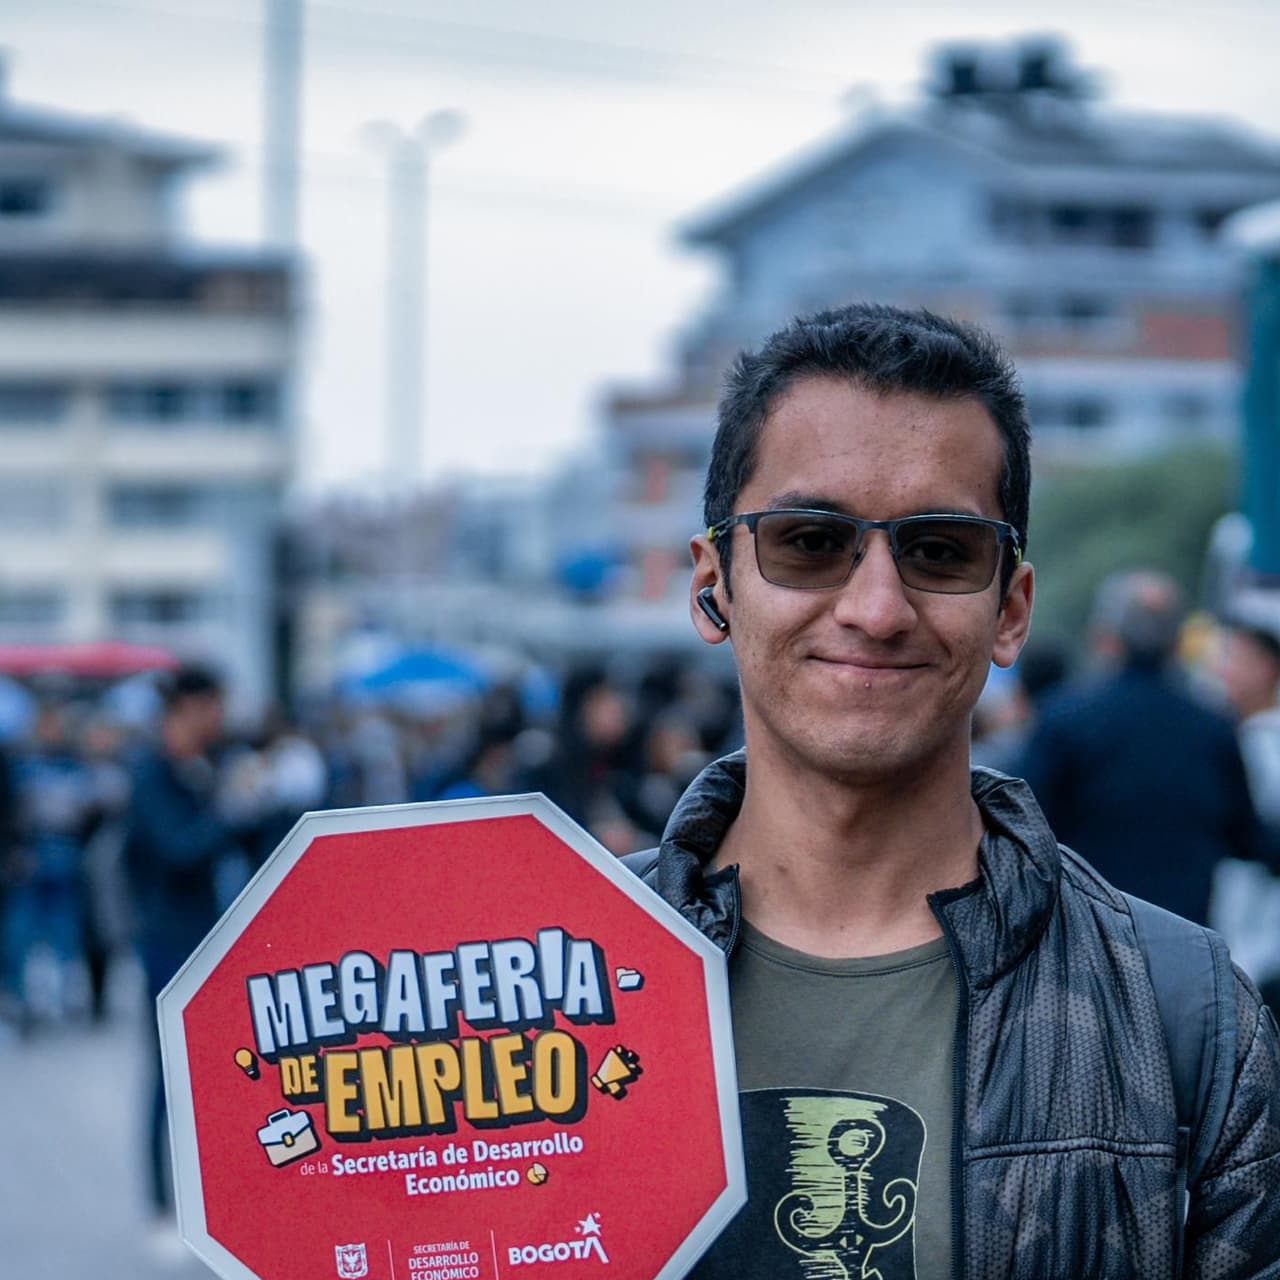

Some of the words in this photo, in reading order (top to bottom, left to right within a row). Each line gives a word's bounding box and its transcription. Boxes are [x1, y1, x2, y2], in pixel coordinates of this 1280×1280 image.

[246, 926, 610, 1059] MEGAFERIA
[278, 1054, 322, 1098] DE
[324, 1030, 582, 1136] EMPLEO
[300, 1161, 315, 1176] de
[317, 1160, 328, 1174] la
[331, 1146, 438, 1176] Secretaría
[442, 1142, 469, 1165] de
[472, 1132, 584, 1162] Desarrollo
[405, 1168, 520, 1196] Económico
[408, 1251, 479, 1270] DESARROLLO
[413, 1241, 459, 1254] SECRETARÍA
[459, 1240, 470, 1250] DE
